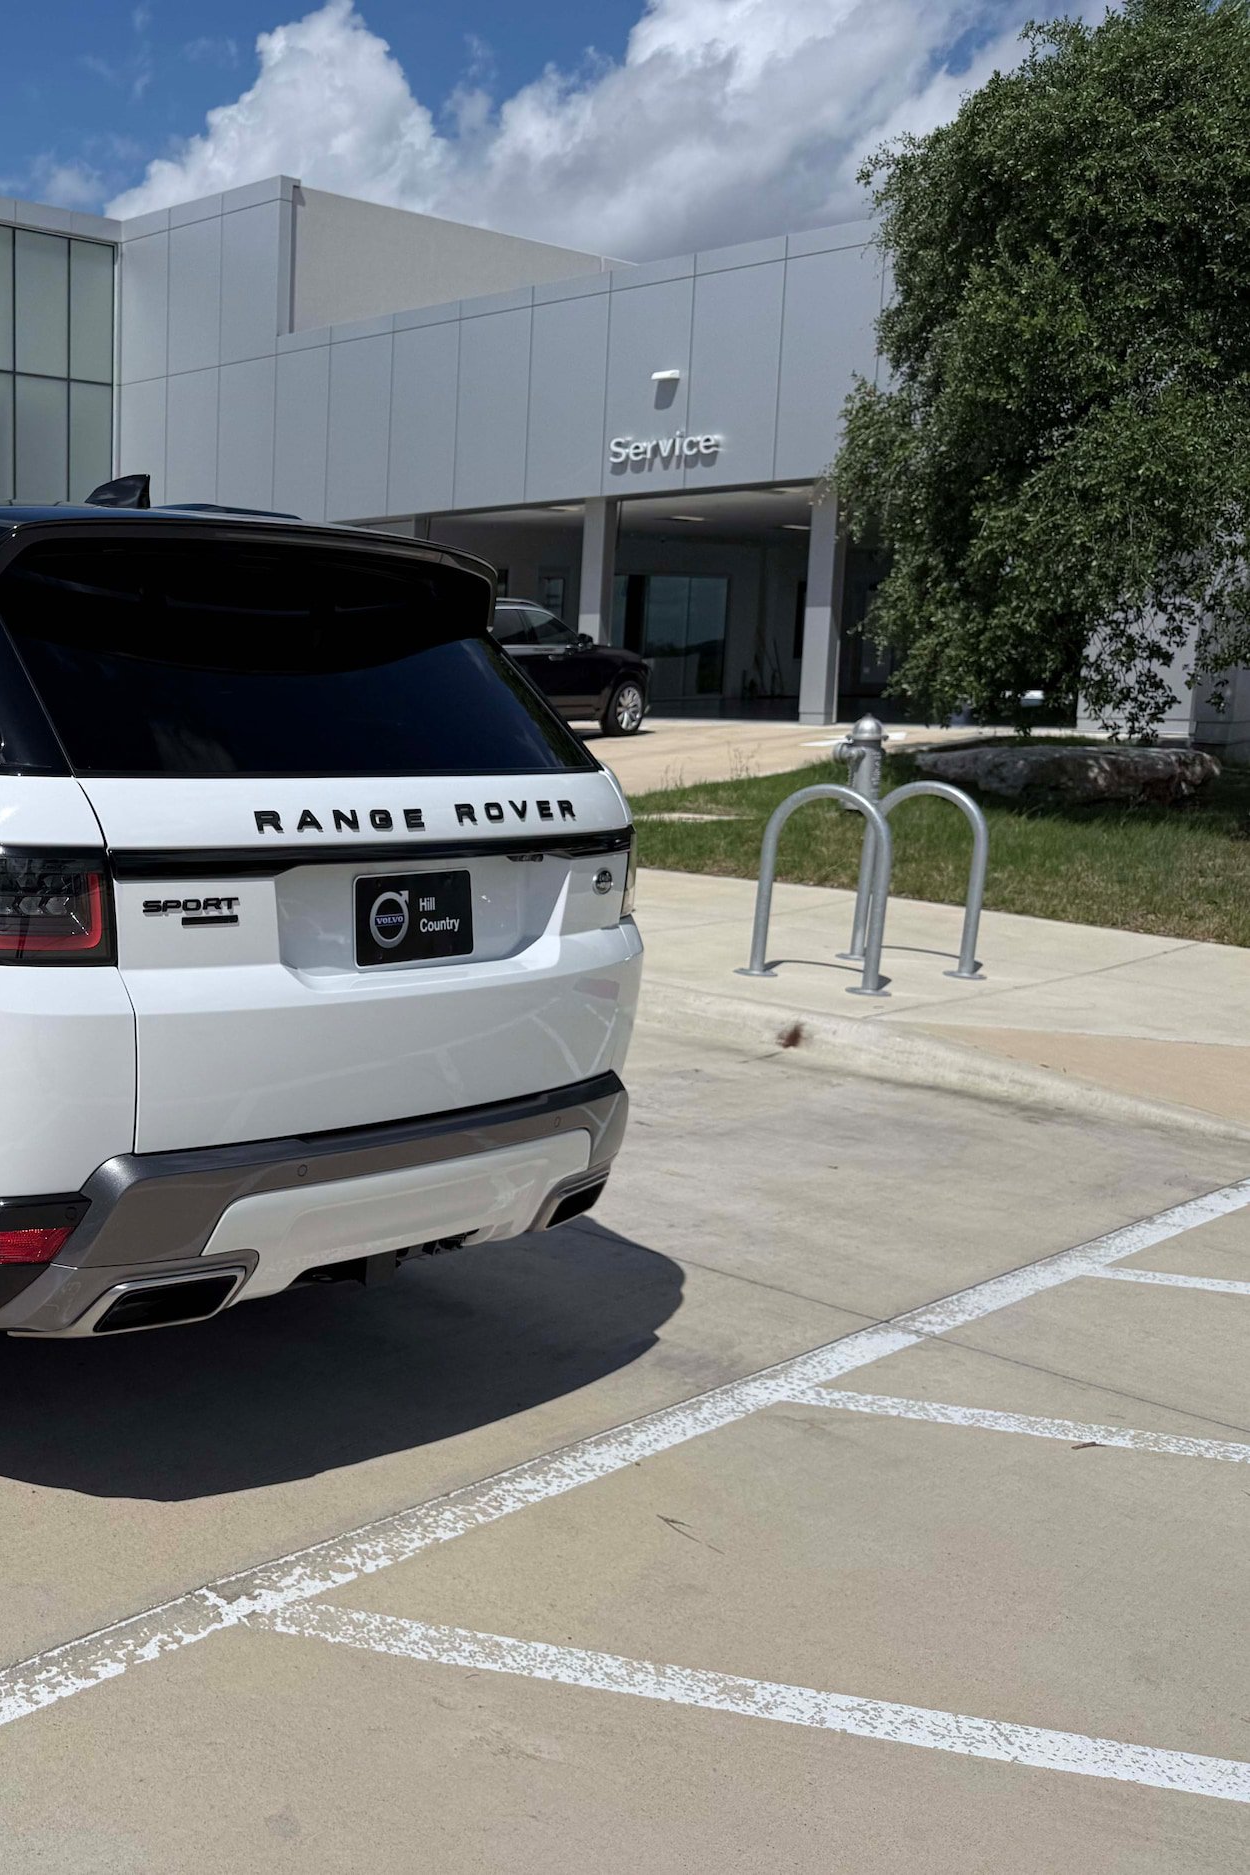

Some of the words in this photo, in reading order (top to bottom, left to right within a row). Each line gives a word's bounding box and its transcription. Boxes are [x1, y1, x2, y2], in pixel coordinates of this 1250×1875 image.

[609, 429, 720, 463] Service
[253, 808, 426, 834] RANGE
[453, 799, 577, 826] ROVER
[142, 897, 239, 914] SPORT
[419, 896, 436, 912] Hill
[376, 915, 404, 925] VOLVO
[419, 917, 460, 933] Country
